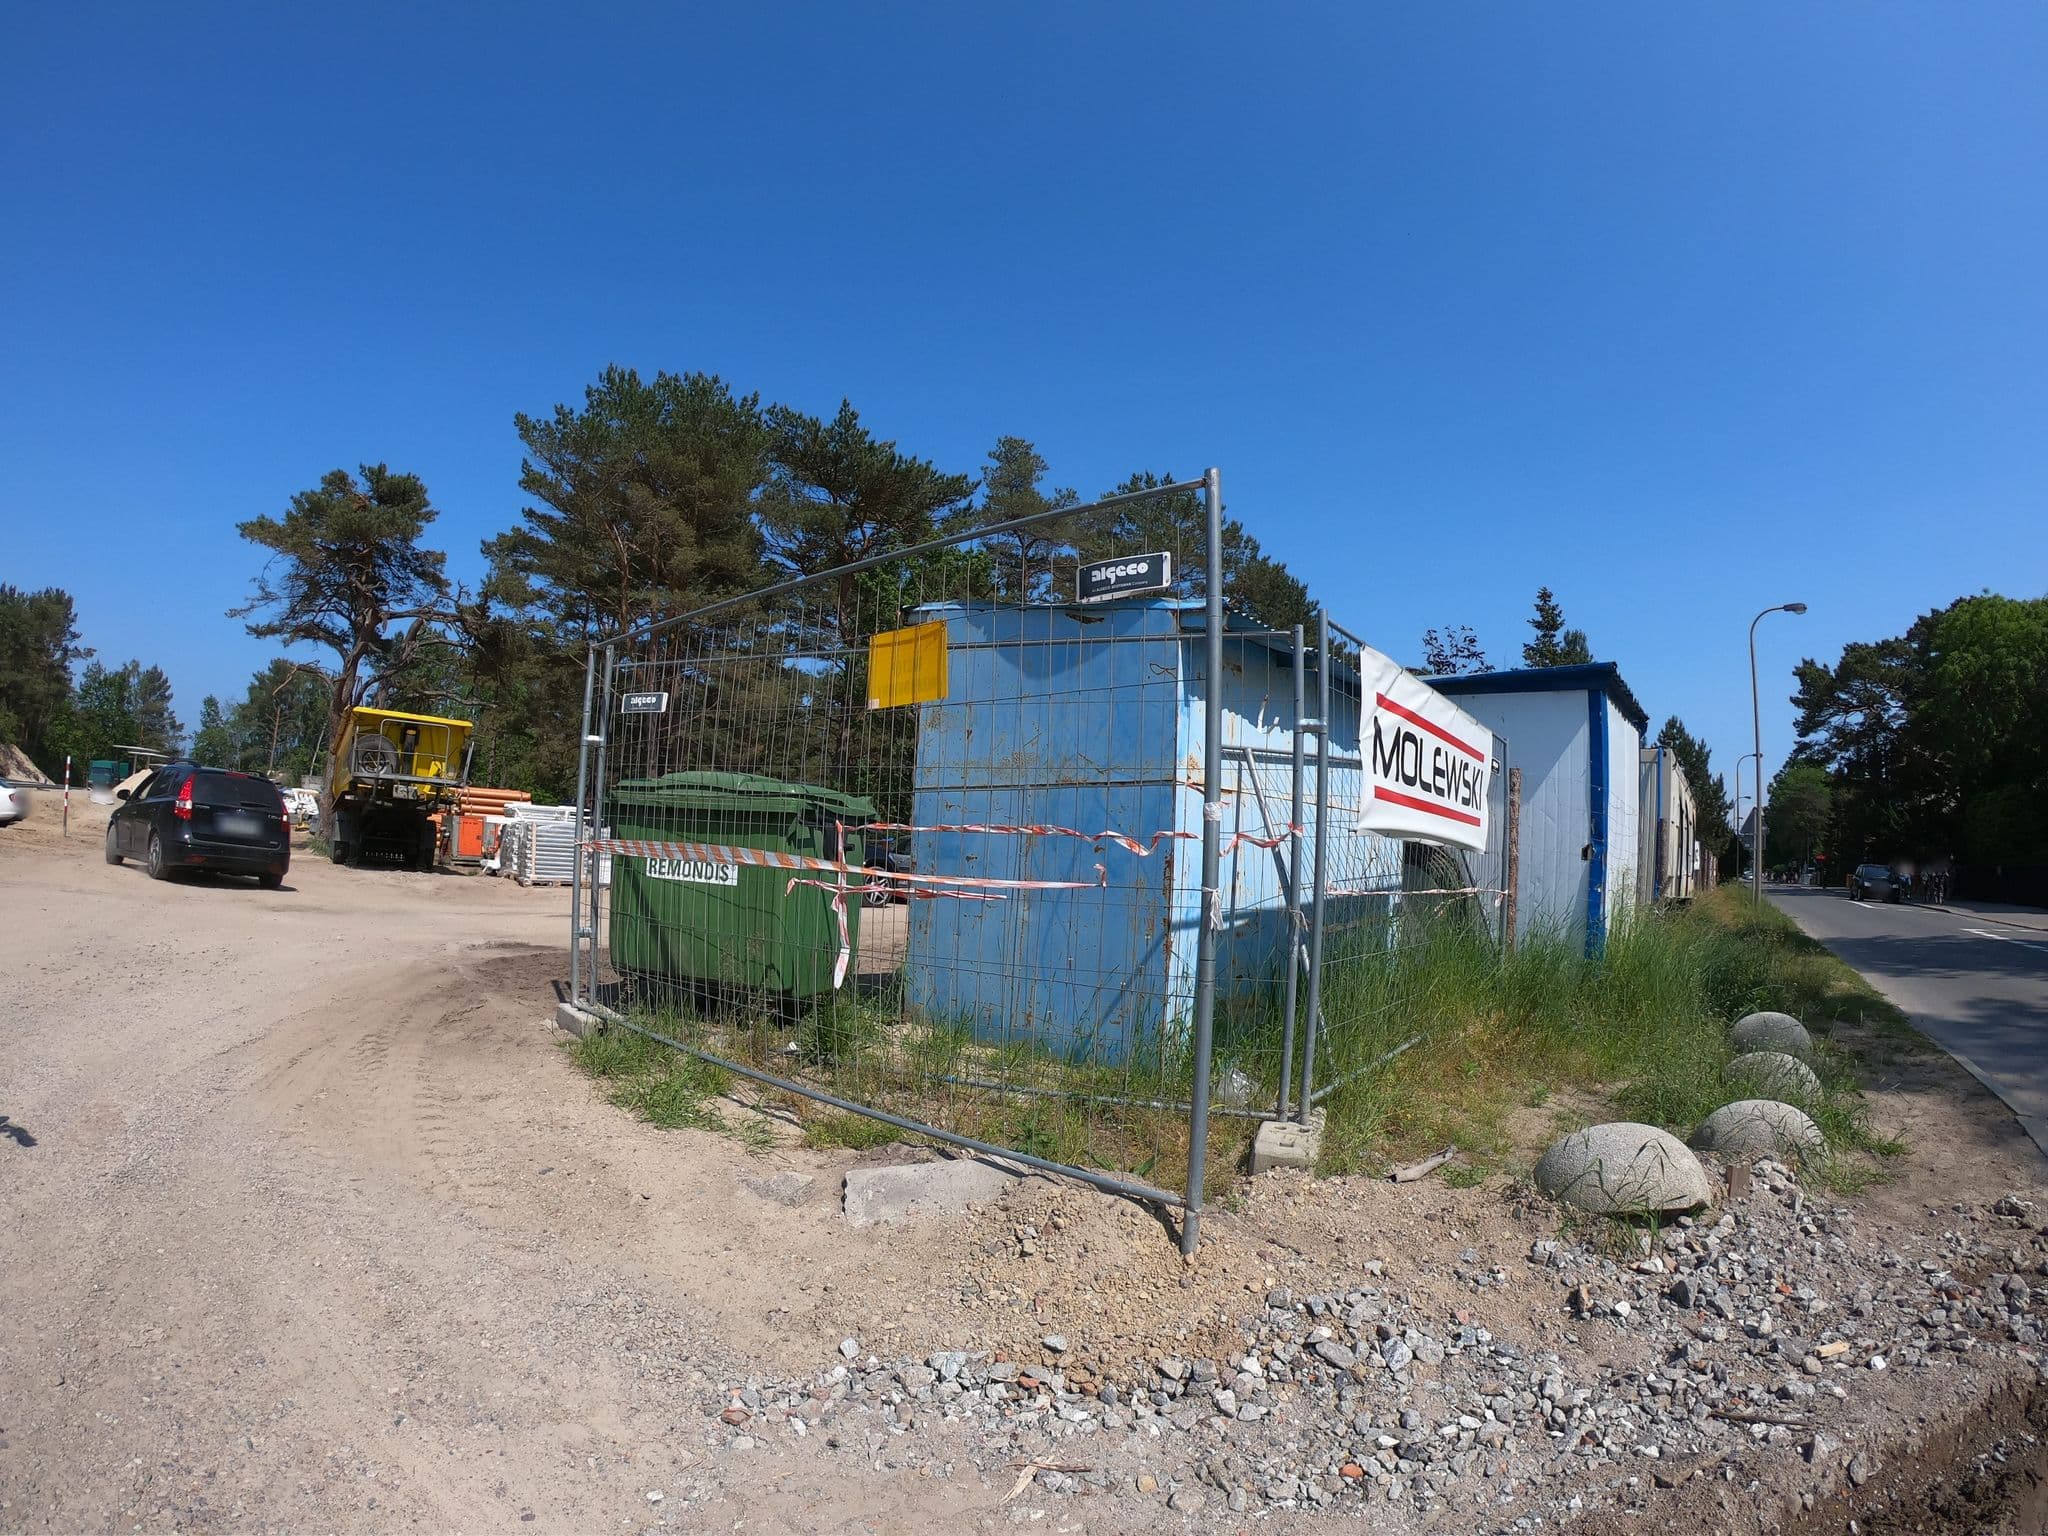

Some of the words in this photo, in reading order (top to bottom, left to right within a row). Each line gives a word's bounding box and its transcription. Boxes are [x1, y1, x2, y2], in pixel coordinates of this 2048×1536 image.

[1091, 562, 1149, 585] algeco
[1373, 715, 1484, 811] MOLEWSKI
[649, 858, 729, 882] REMONDIS
